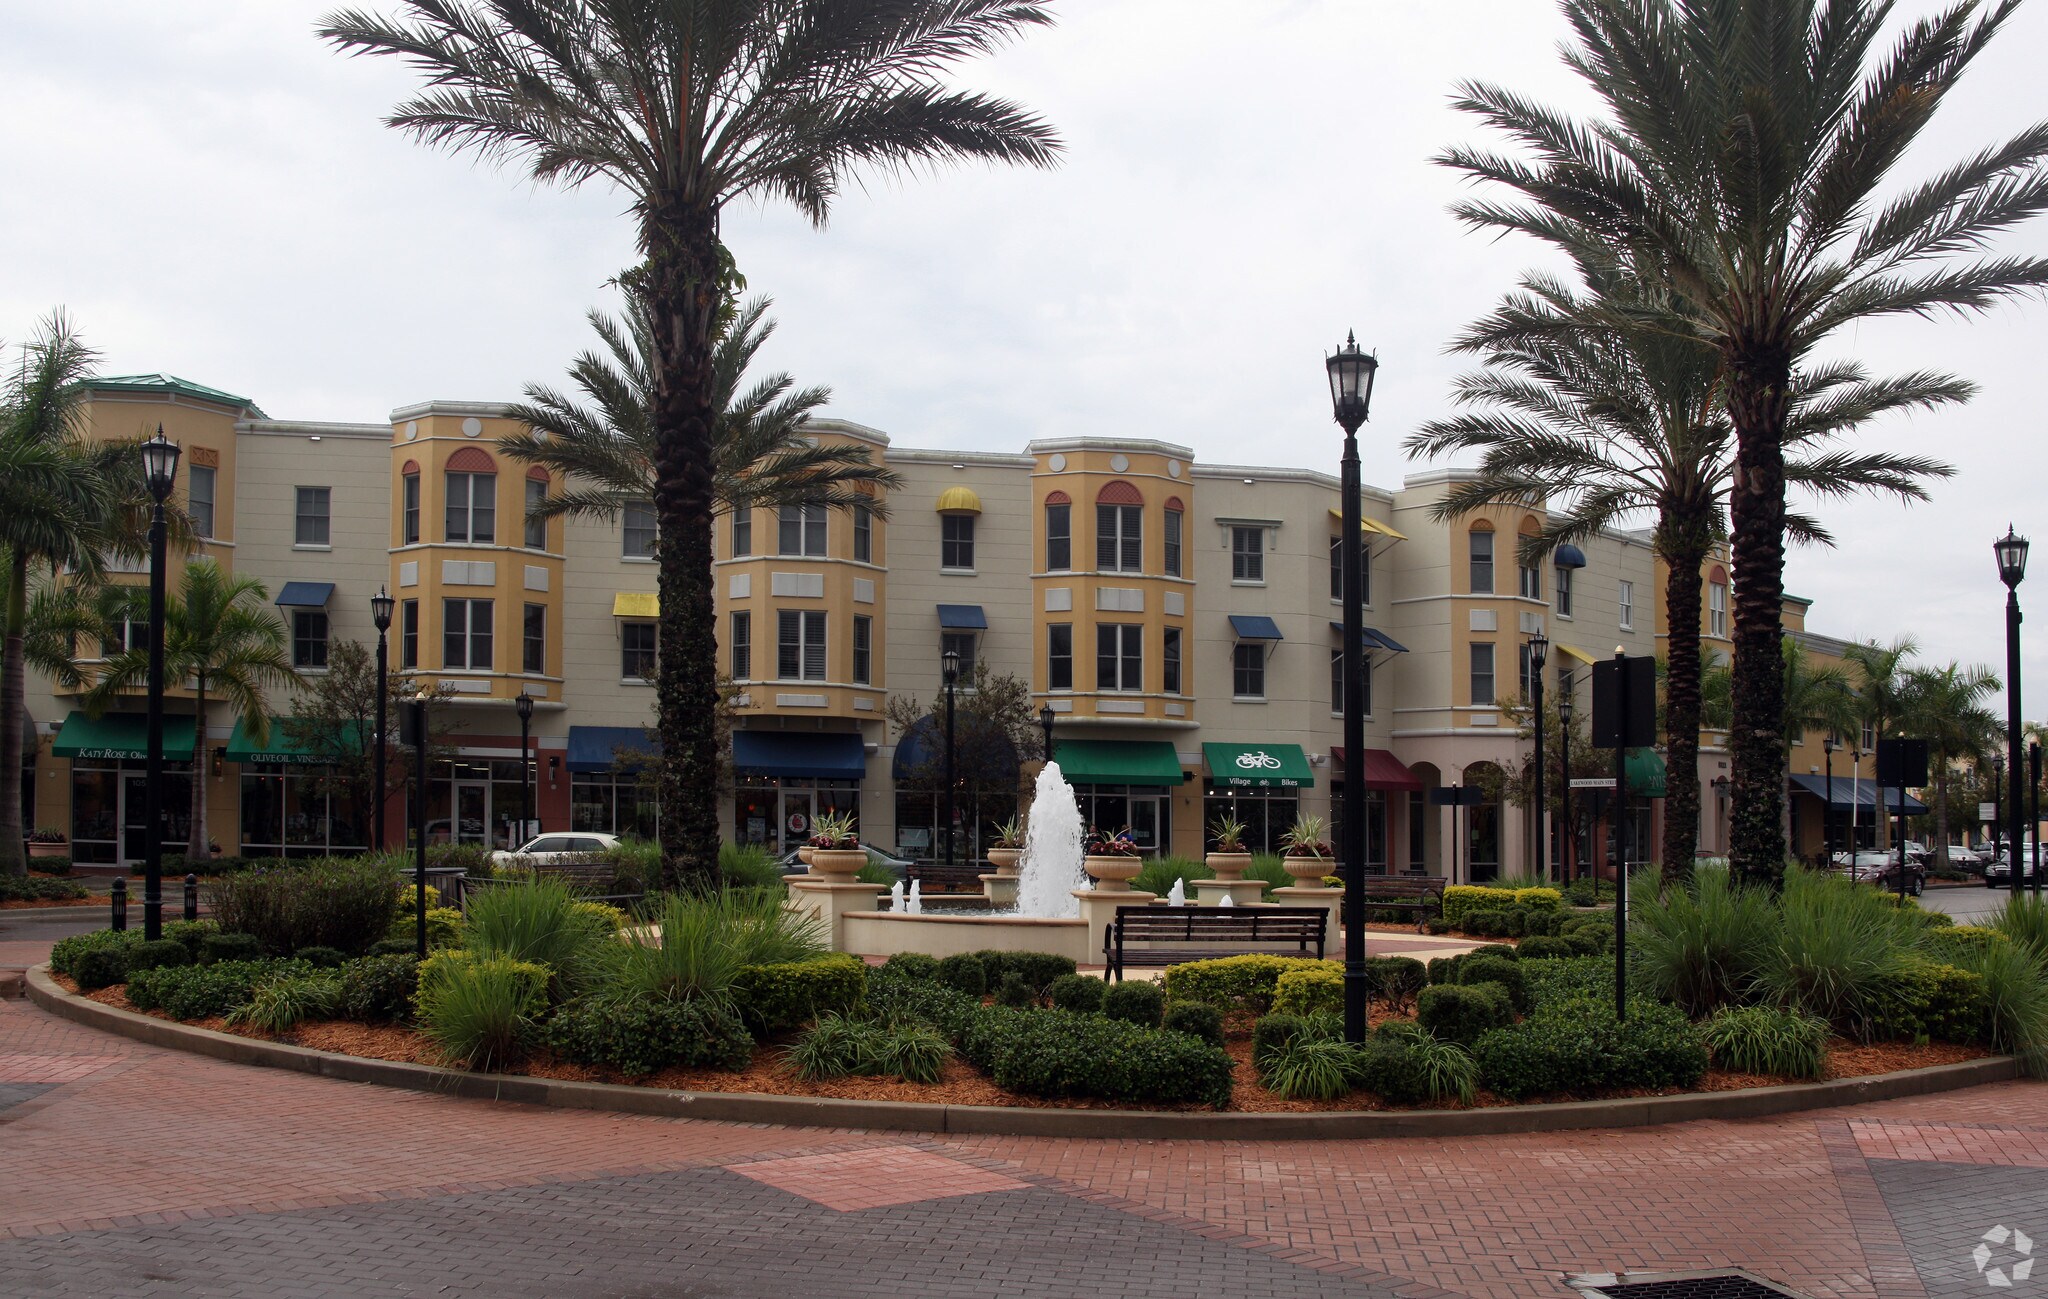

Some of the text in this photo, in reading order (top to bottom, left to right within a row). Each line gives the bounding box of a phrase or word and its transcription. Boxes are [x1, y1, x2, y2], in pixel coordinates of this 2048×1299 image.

[78, 748, 104, 758] KATY
[104, 748, 127, 759] ROSE
[250, 753, 276, 762] OLIVE
[276, 753, 291, 763] OIL
[1229, 777, 1298, 787] Village Bikes
